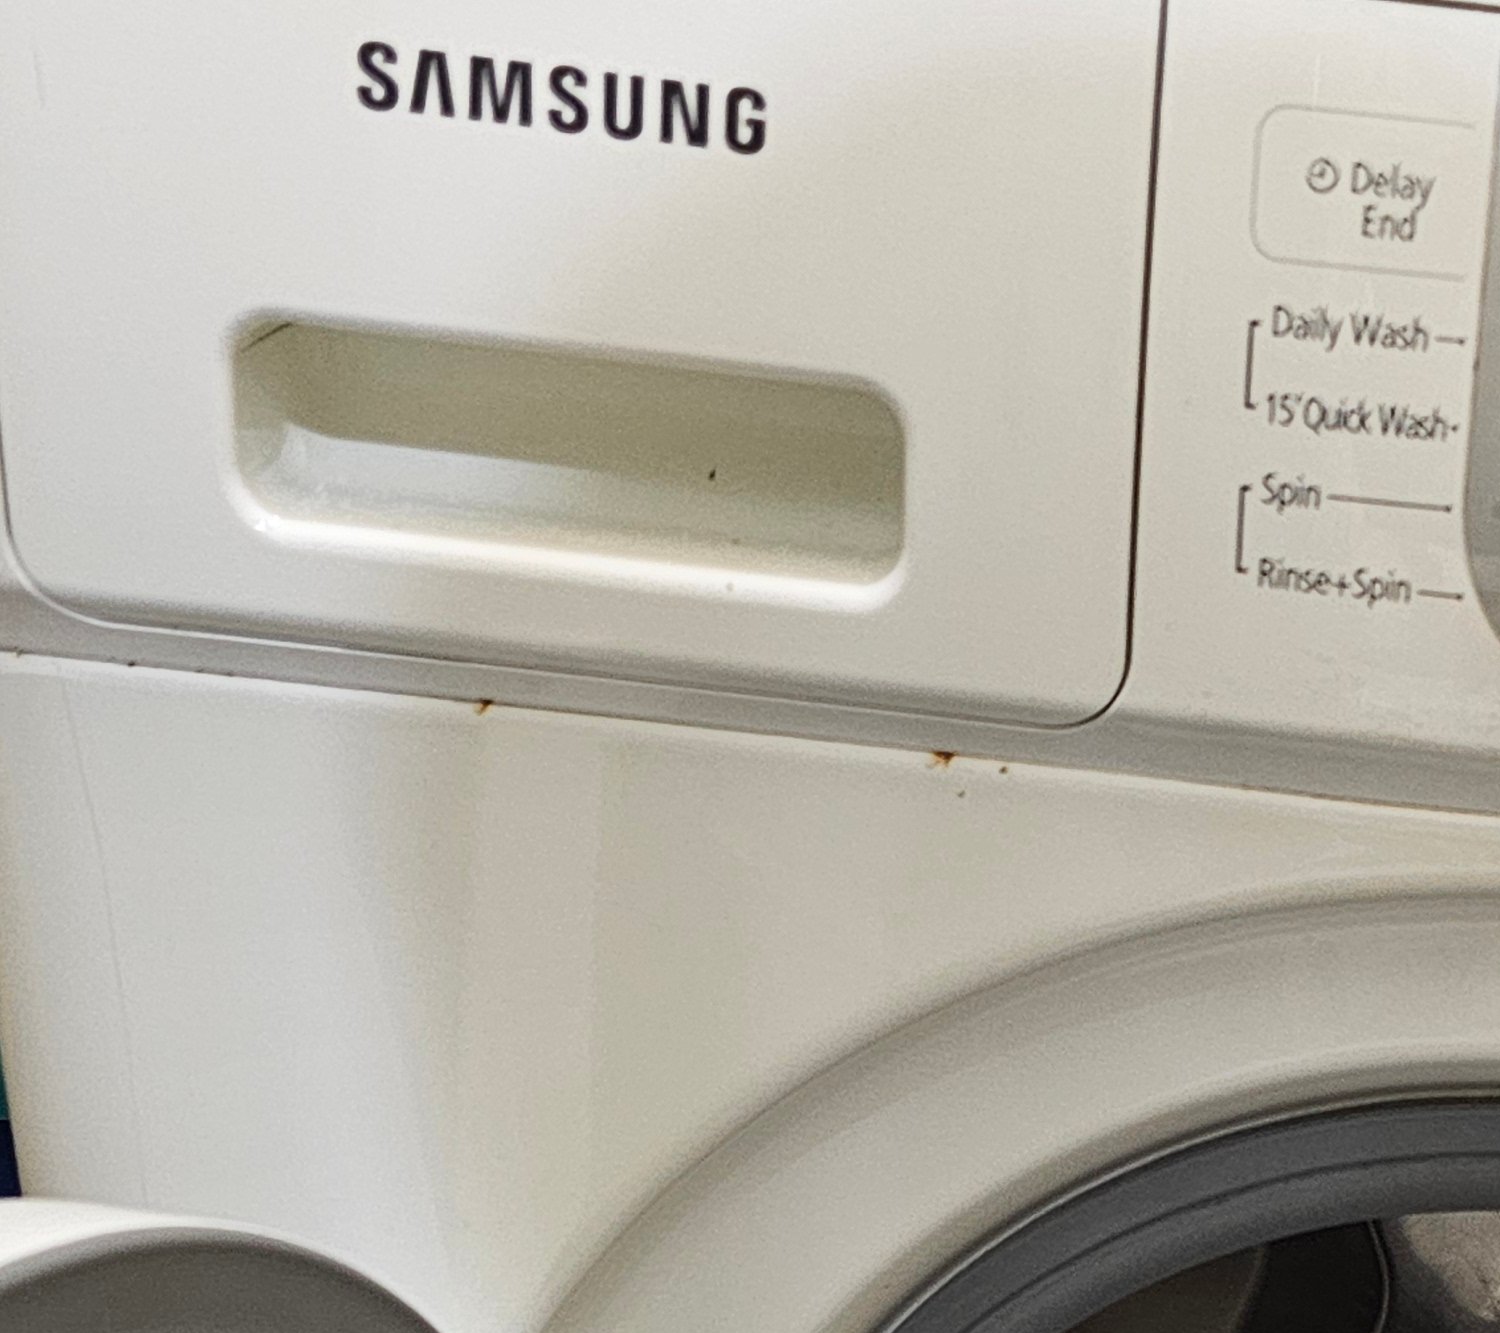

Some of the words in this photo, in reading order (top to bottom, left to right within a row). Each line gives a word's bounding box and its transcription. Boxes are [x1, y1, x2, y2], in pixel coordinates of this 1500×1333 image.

[357, 41, 767, 155] SAMSUNG
[1350, 161, 1435, 210] Delay
[1360, 204, 1416, 242] End
[1271, 304, 1343, 353] Daily
[1350, 313, 1430, 352] Wash
[1378, 405, 1450, 441] Wash
[1260, 472, 1322, 515] Spin
[1256, 557, 1412, 609] Rinse+Spin
